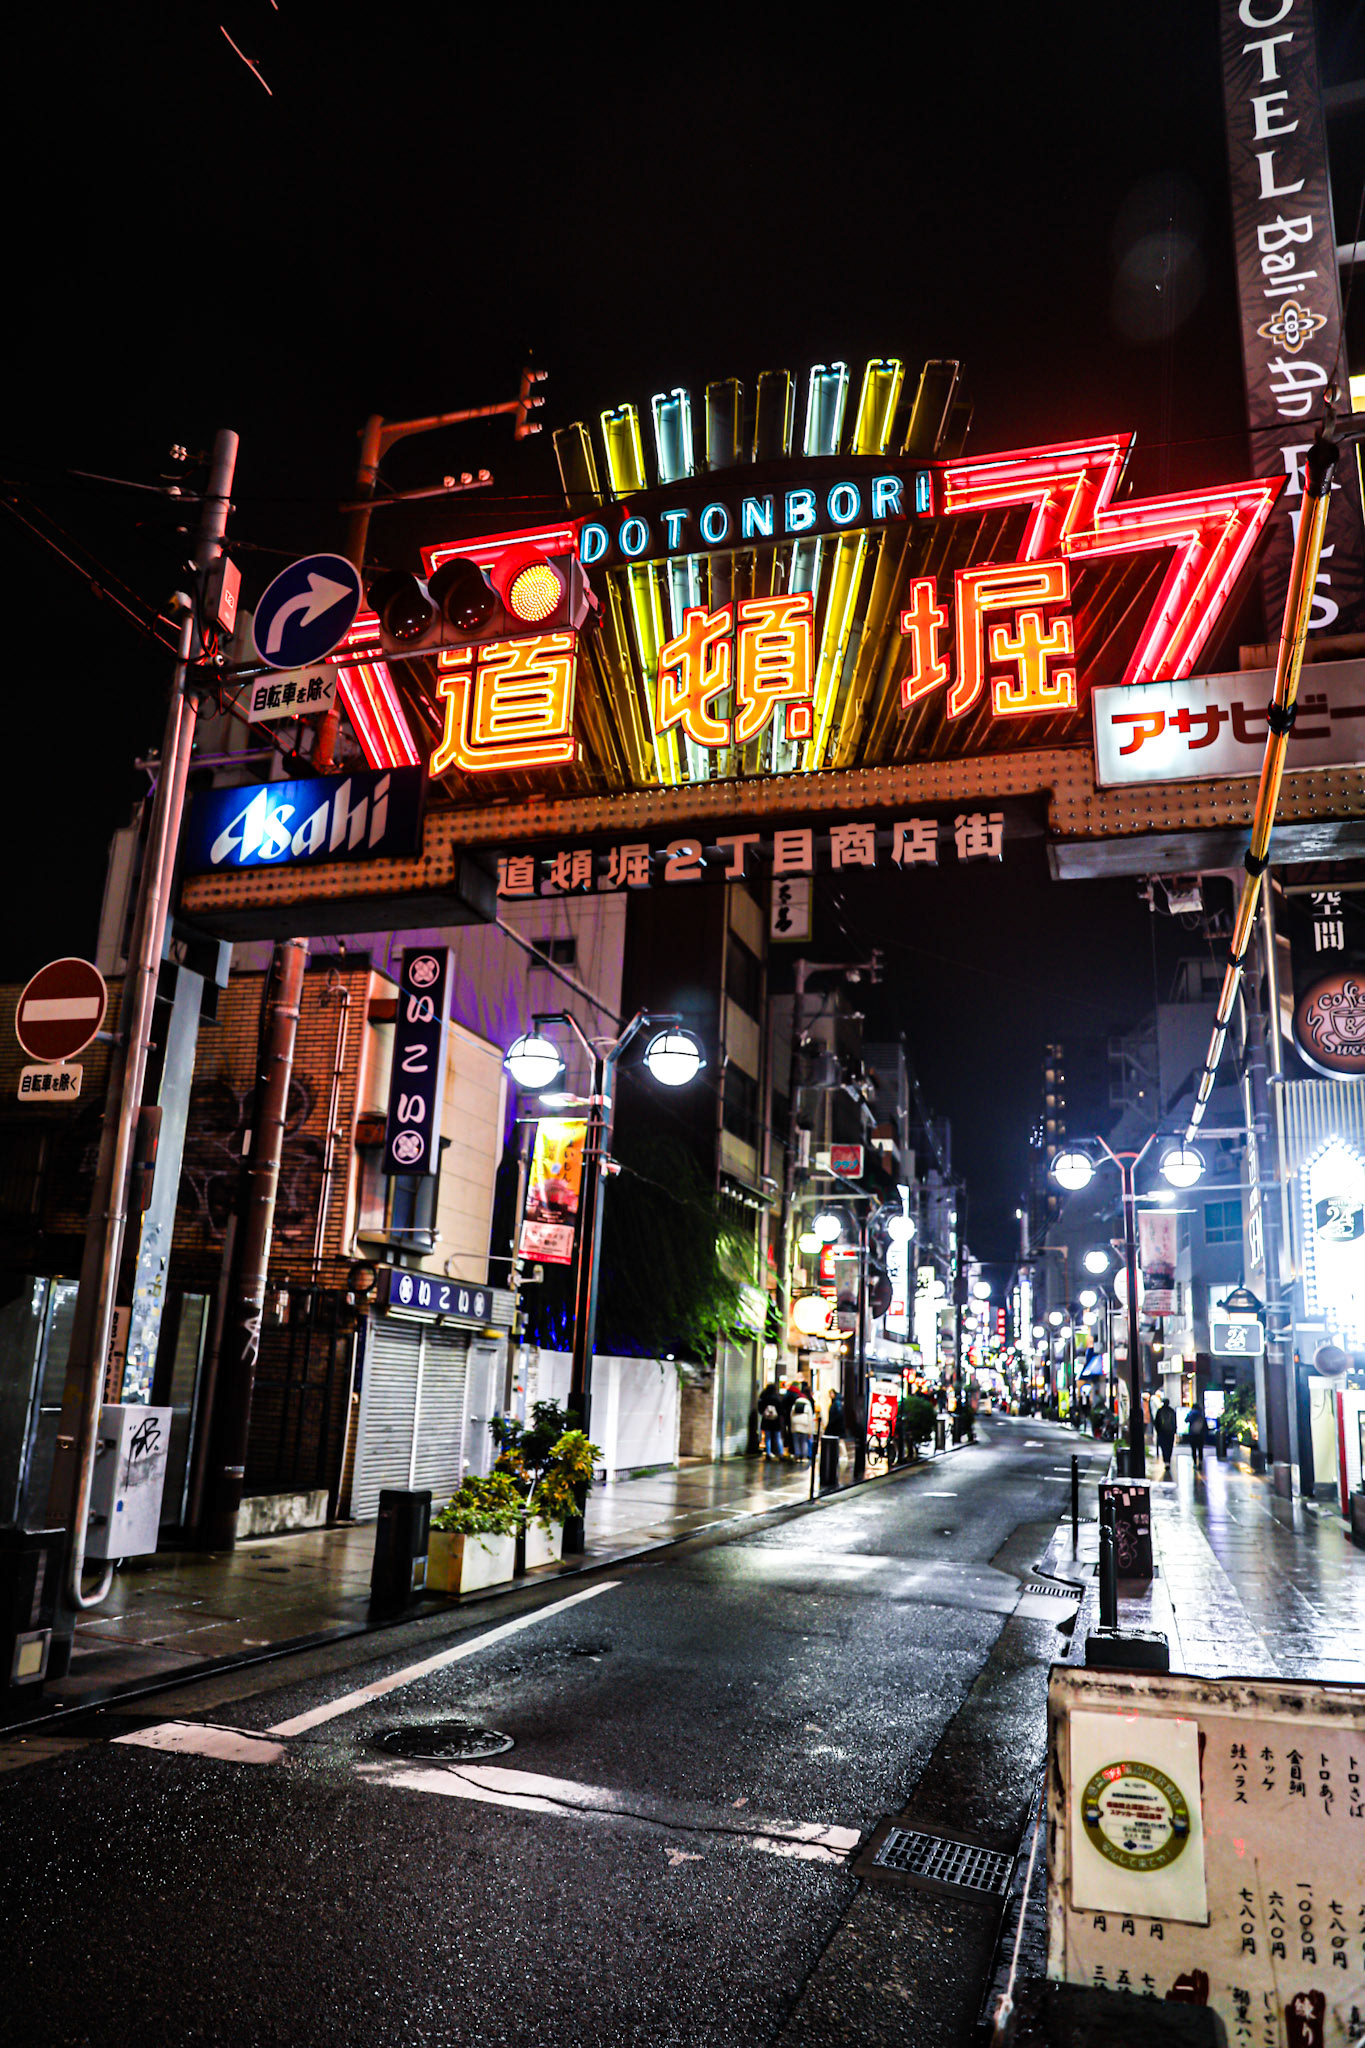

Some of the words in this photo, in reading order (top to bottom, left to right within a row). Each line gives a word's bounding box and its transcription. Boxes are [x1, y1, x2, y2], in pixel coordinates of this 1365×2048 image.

[579, 470, 934, 564] DOTONBORI
[253, 676, 333, 711] 自転車を除く
[428, 557, 1079, 780] 道頓堀
[210, 773, 391, 865] Asahi
[496, 812, 1005, 896] 道頓堀2丁目商店街
[21, 1073, 78, 1092] 自転車を除く
[1259, 1746, 1276, 1792] ホッケ
[1347, 1756, 1365, 1818] トロさば
